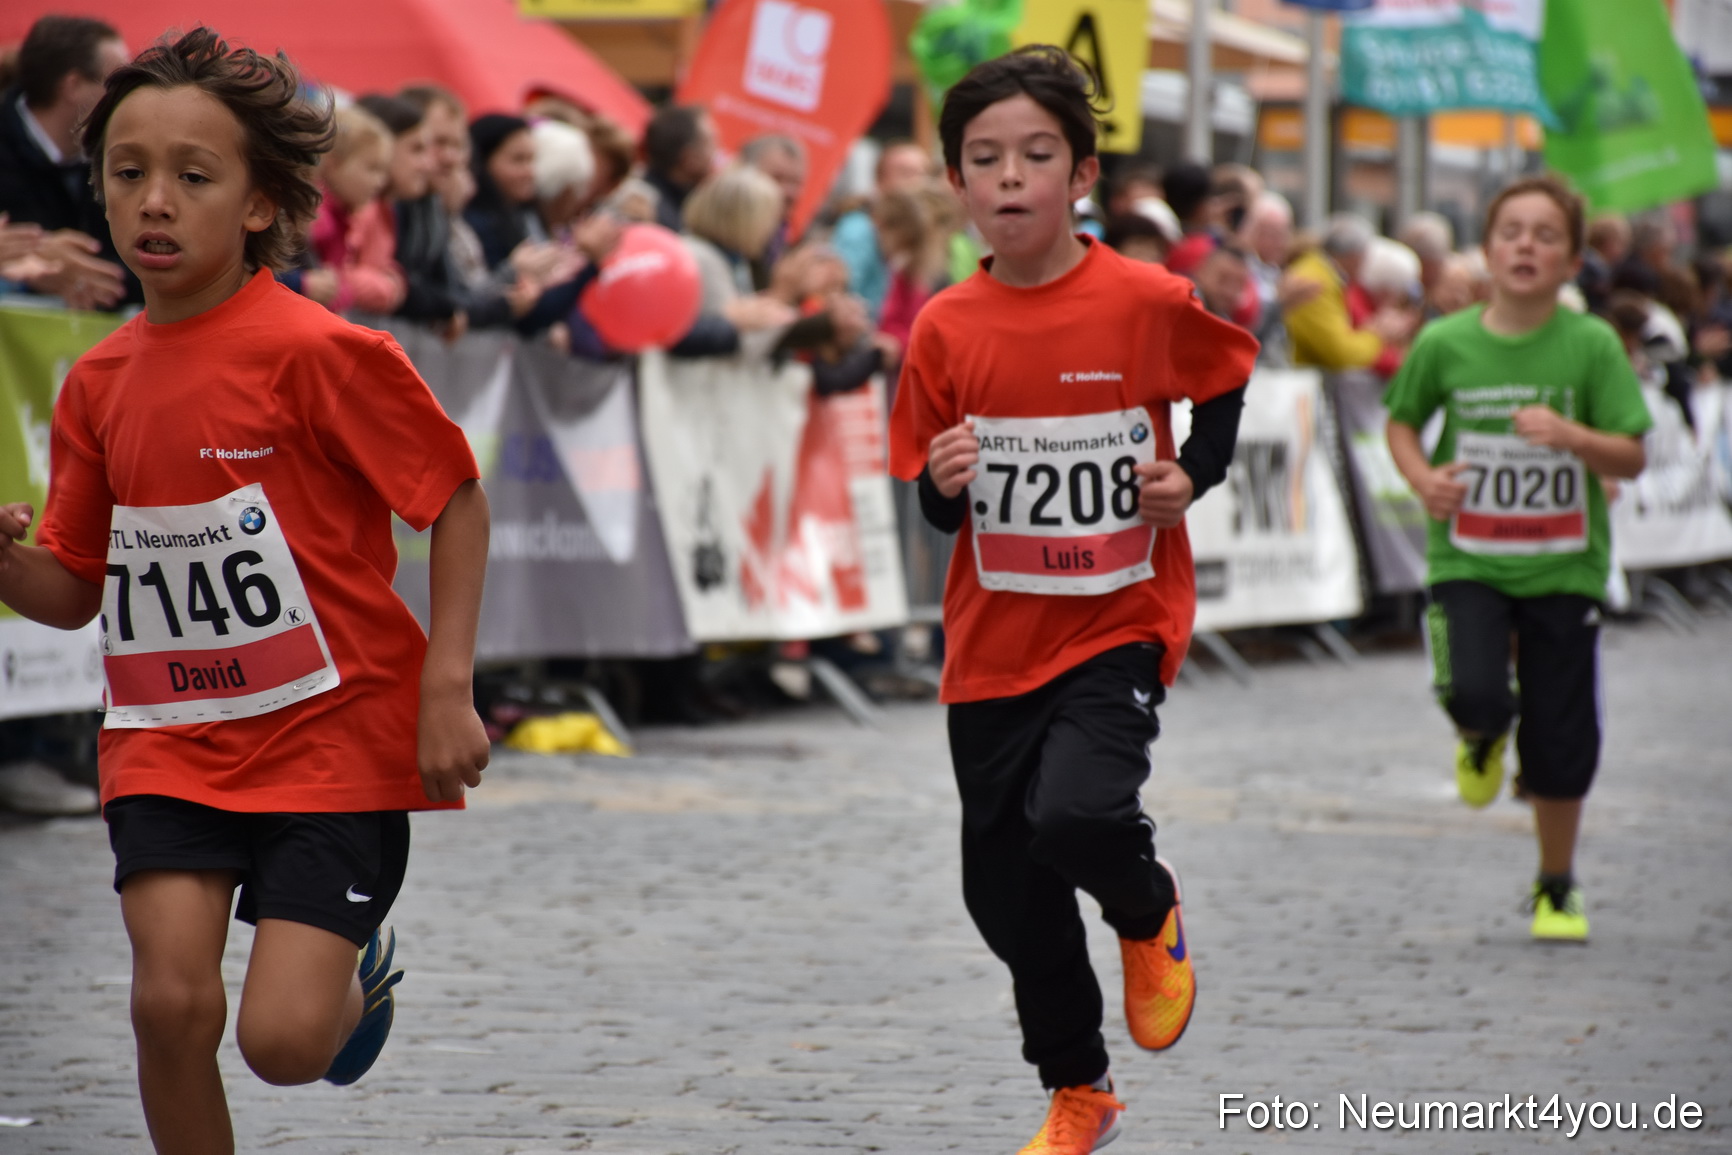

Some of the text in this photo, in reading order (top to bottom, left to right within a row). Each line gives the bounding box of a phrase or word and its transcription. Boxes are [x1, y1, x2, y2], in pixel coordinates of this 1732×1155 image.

[1060, 372, 1122, 383] FC Holzheim
[200, 446, 273, 459] FC Holzheim
[1034, 432, 1124, 453] Neumarkt
[986, 456, 1140, 526] 7208
[1468, 466, 1576, 509] 7020
[136, 525, 232, 550] Neumarkt
[1043, 546, 1095, 569] Luis
[106, 550, 281, 641] 7146
[289, 610, 300, 623] K
[168, 658, 247, 692] David
